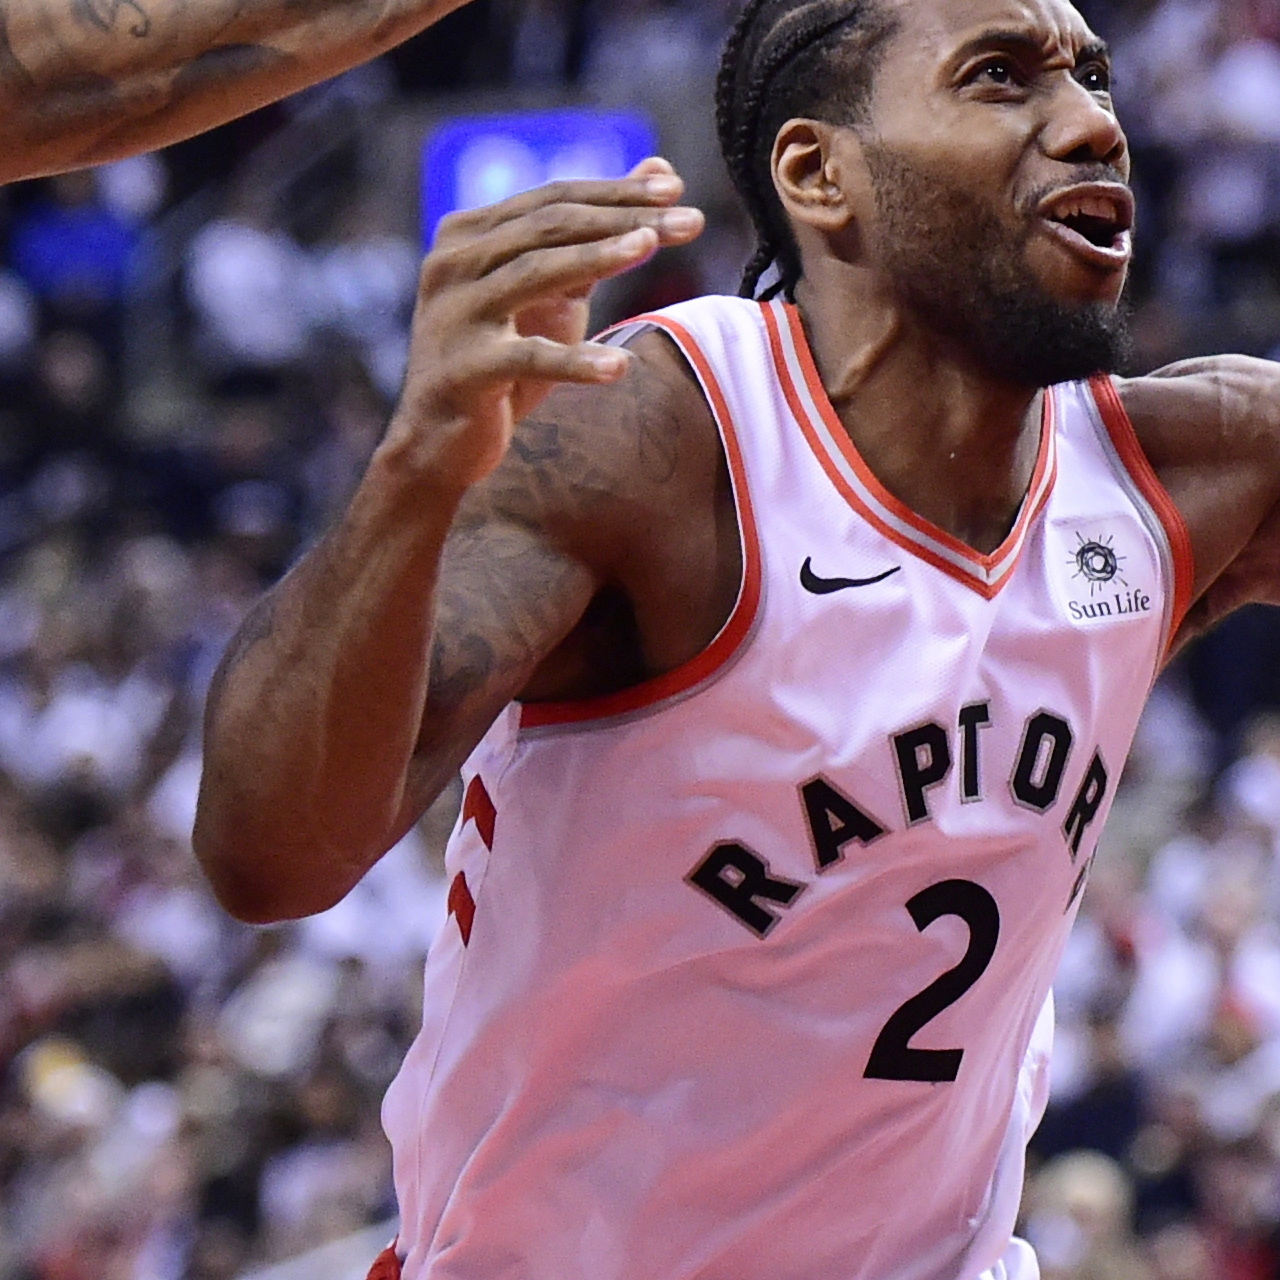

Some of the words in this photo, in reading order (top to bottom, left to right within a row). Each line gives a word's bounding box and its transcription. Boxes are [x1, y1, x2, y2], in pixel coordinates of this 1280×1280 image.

[1068, 600, 1112, 620] Sun
[1114, 588, 1151, 614] Life
[863, 878, 1001, 1082] 2
